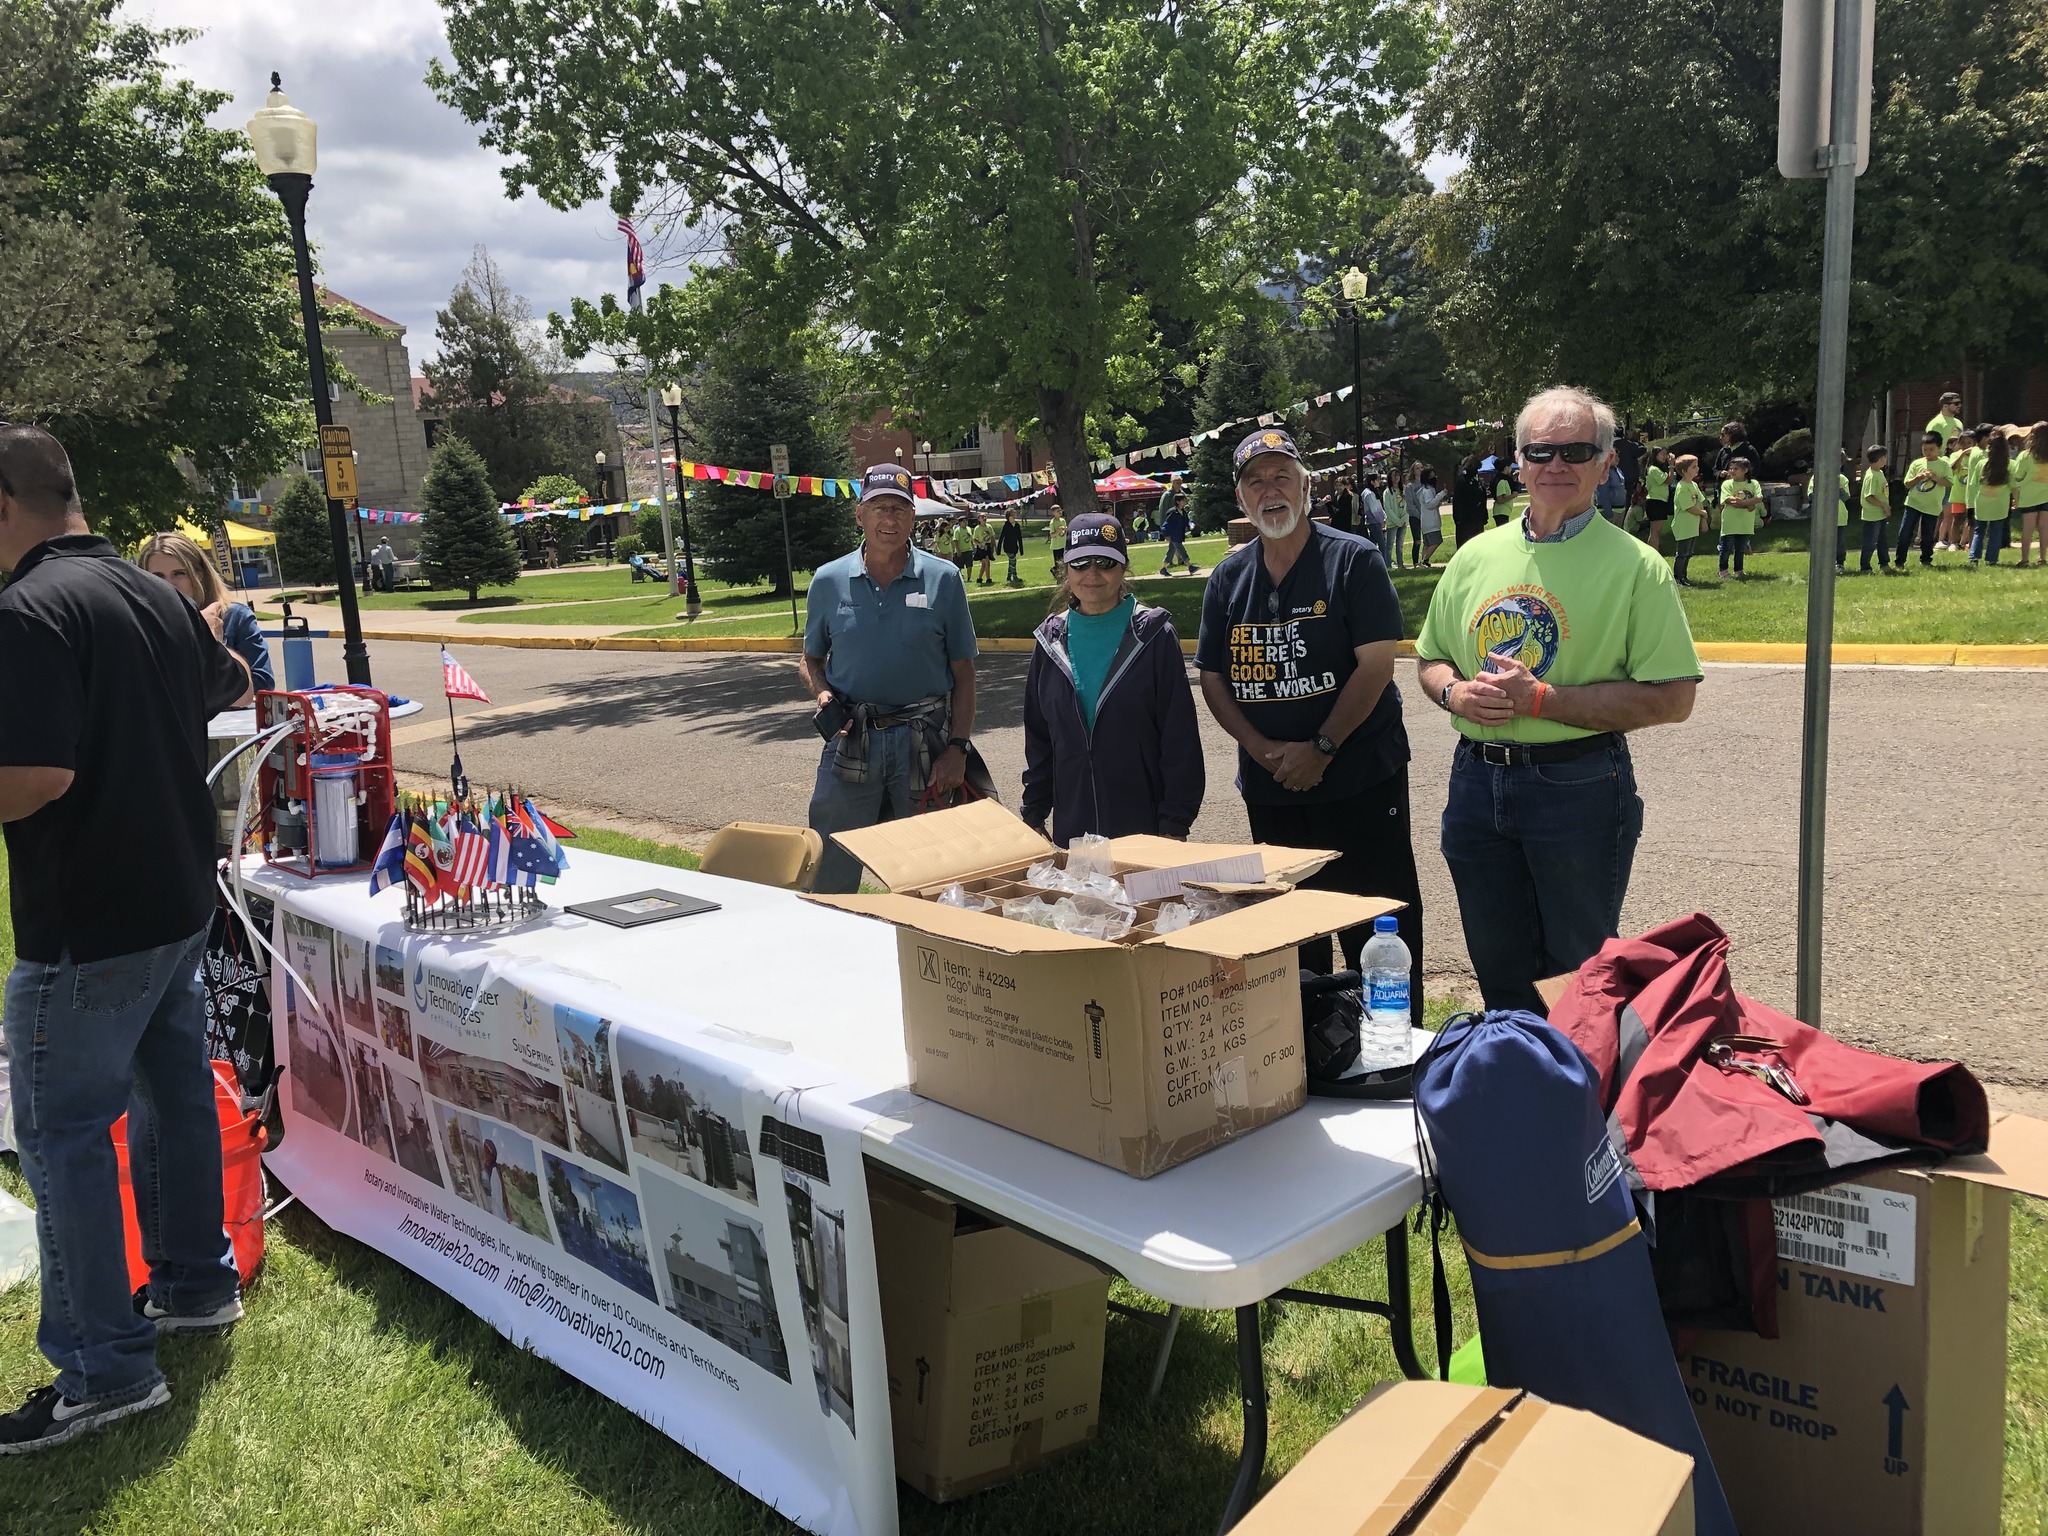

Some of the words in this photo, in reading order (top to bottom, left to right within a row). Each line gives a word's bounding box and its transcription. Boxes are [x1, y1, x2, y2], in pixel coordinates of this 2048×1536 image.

[324, 430, 349, 443] CAUTION
[337, 461, 344, 479] 5
[869, 473, 895, 483] Rotary
[1071, 528, 1100, 537] Rotary
[1292, 606, 1312, 614] Rotary
[1469, 590, 1504, 635] TRINIDAD
[1507, 584, 1544, 595] WATER
[1544, 592, 1571, 641] FESTIVAL
[1230, 621, 1300, 644] BELIEVE
[1478, 612, 1526, 659] AGUA
[1230, 644, 1288, 662] THERE
[1292, 640, 1307, 658] IS
[1230, 664, 1276, 681] GOOD
[1283, 661, 1298, 679] IN
[1232, 682, 1267, 699] THE
[1274, 672, 1336, 697] WORLD
[944, 957, 971, 978] item:
[428, 970, 473, 999] Innovative
[476, 984, 499, 1006] ater
[972, 983, 991, 998] ultra
[1160, 987, 1184, 1004] PO#
[1162, 1001, 1190, 1022] ITEM
[1193, 994, 1215, 1011] NO.:
[1270, 966, 1287, 983] gray
[428, 990, 482, 1025] Technologes
[984, 1005, 1002, 1017] storm
[1004, 1011, 1019, 1023] gray
[464, 1028, 491, 1040] water
[1164, 1020, 1193, 1038] Q'TY:
[1200, 1012, 1212, 1026] 24
[949, 1027, 978, 1044] quantity:
[986, 1038, 994, 1048] 24
[1000, 1021, 1018, 1035] single
[1019, 1026, 1031, 1037] wall
[1032, 1031, 1053, 1044] plastic
[1053, 1034, 1073, 1051] bottle
[1164, 1038, 1195, 1058] N.W.:
[1200, 1028, 1214, 1044] 2.4
[1222, 1017, 1245, 1036] KGS
[1046, 1046, 1075, 1062] chamber
[1166, 1055, 1196, 1075] G.W.:
[1202, 1046, 1216, 1060] 3.2
[1224, 1033, 1246, 1052] KGS
[1168, 1079, 1215, 1107] CARTON
[1263, 1052, 1276, 1067] OF
[1279, 1045, 1295, 1060] 300
[1168, 1069, 1201, 1092] CUFT:
[1838, 1242, 1849, 1250] QTY
[1851, 1244, 1864, 1254] PER
[364, 1169, 384, 1192] Rotary
[384, 1179, 396, 1196] and
[397, 1185, 429, 1214] Innovative
[430, 1202, 450, 1225] Water
[450, 1214, 497, 1252] Technologies,
[499, 1238, 515, 1262] Inc.,
[516, 1251, 546, 1279] working
[547, 1265, 580, 1295] together
[581, 1284, 590, 1299] in
[591, 1294, 610, 1312] over
[612, 1302, 624, 1321] 10
[625, 1310, 668, 1348] Countries
[669, 1338, 688, 1360] and
[688, 1348, 740, 1391] Territories
[1799, 1270, 1887, 1313] TANK
[504, 1269, 665, 1380] info@innovativeh2o.com
[976, 1350, 996, 1363] PO#
[975, 1362, 999, 1378] ITEM
[1006, 1372, 1017, 1383] 24
[1026, 1364, 1046, 1377] PCS
[1024, 1378, 1044, 1392] KGS
[1690, 1355, 1819, 1411] FRAGILE
[1023, 1392, 1044, 1406] KGS
[968, 1427, 1011, 1447] CARTON
[1056, 1408, 1068, 1420] OF
[1073, 1403, 1088, 1416] 375
[970, 1419, 1000, 1435] CUFT:
[1716, 1394, 1761, 1421] NOT
[1769, 1409, 1837, 1441] DROP
[1884, 1457, 1909, 1477] UP
